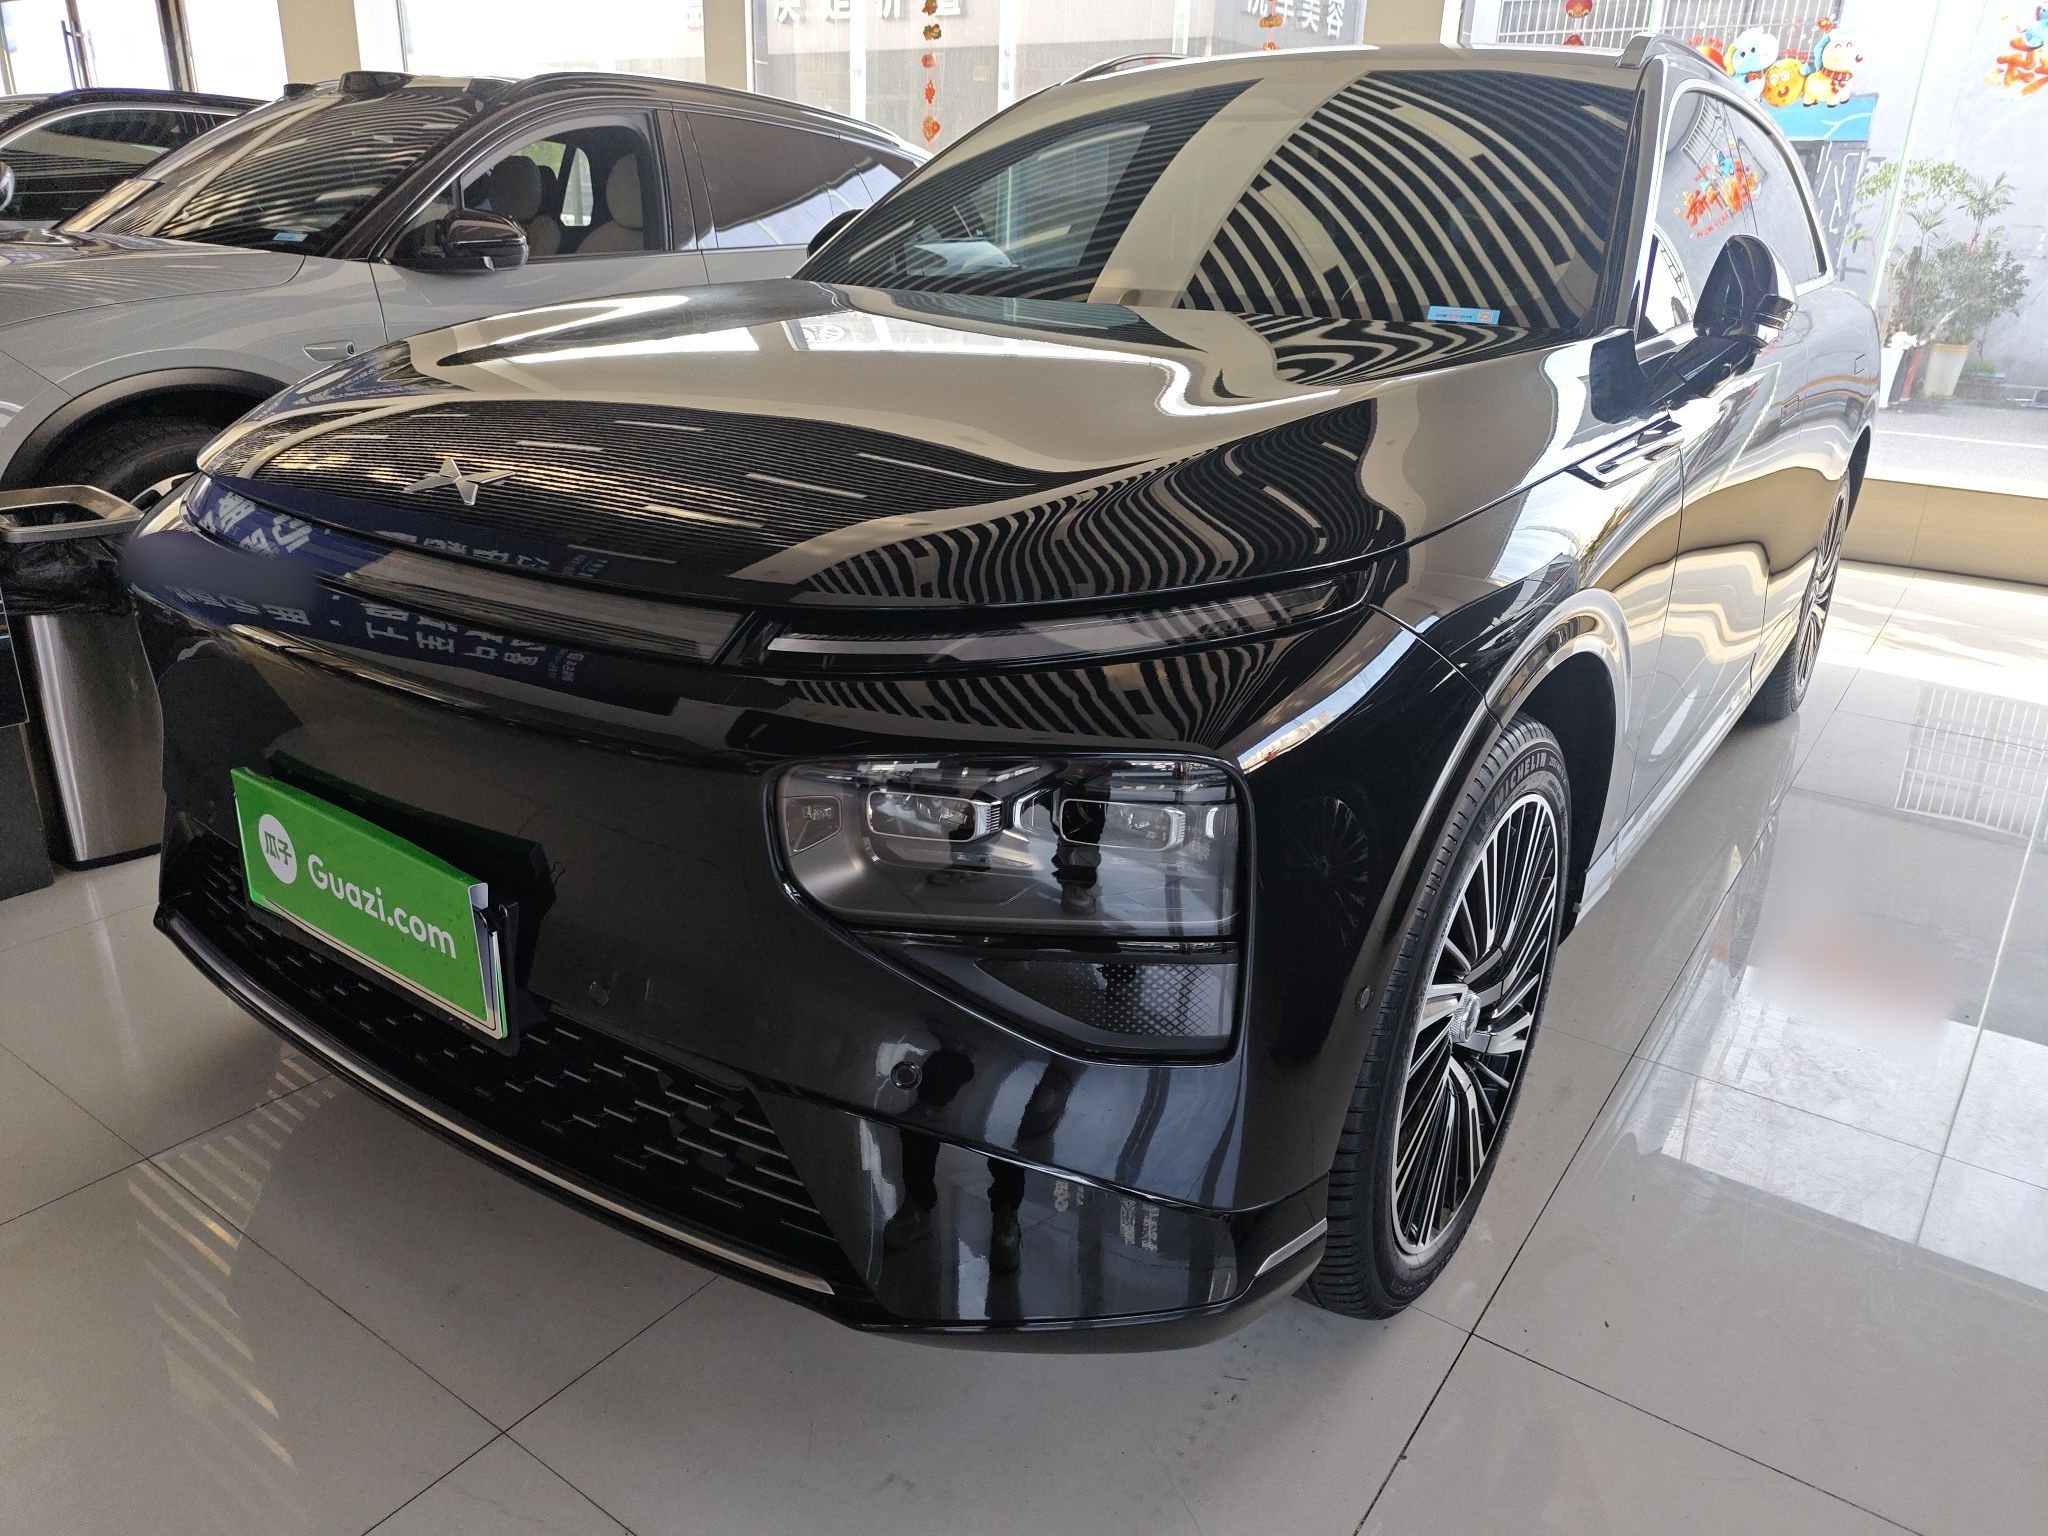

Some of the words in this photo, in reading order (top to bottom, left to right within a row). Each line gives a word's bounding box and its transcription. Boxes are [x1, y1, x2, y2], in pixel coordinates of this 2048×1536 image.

[1494, 752, 1547, 814] MICHELIN
[264, 830, 293, 867] 瓜子
[308, 853, 457, 960] Guazi.com
